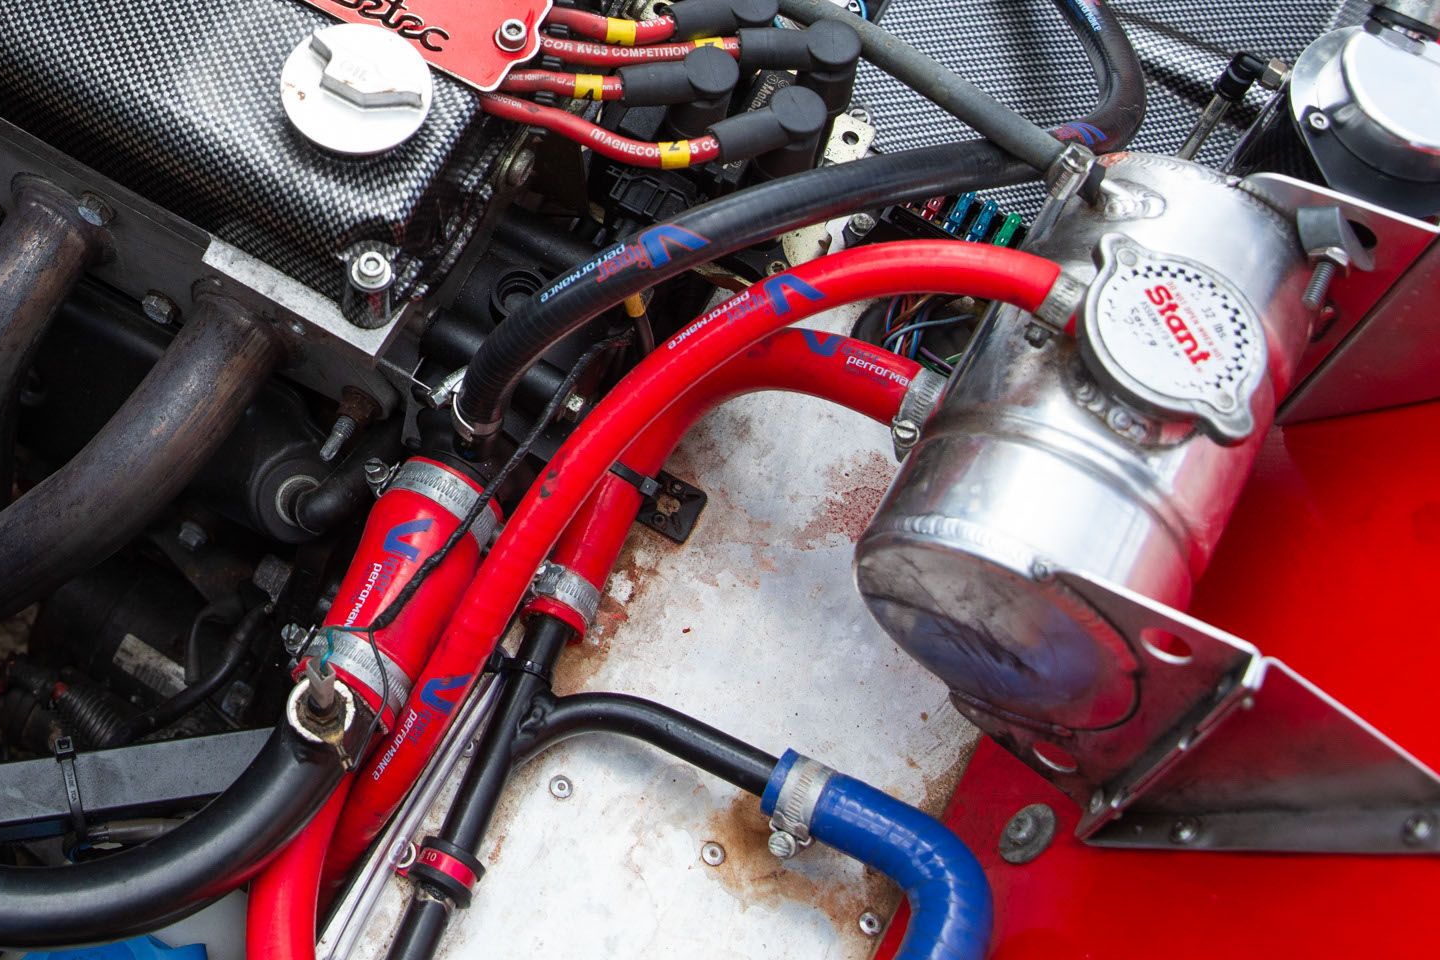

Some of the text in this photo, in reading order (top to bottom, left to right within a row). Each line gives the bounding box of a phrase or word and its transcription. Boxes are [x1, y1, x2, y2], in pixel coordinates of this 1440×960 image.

[577, 43, 608, 56] KV85
[611, 45, 689, 58] COMPETITION
[538, 243, 627, 302] performance
[595, 224, 711, 283] Viper
[666, 290, 750, 349] performance
[726, 273, 826, 325] Viper
[1144, 285, 1211, 365] Stant
[375, 518, 433, 595] Viper
[407, 673, 472, 747] Viper
[371, 709, 417, 780] performance
